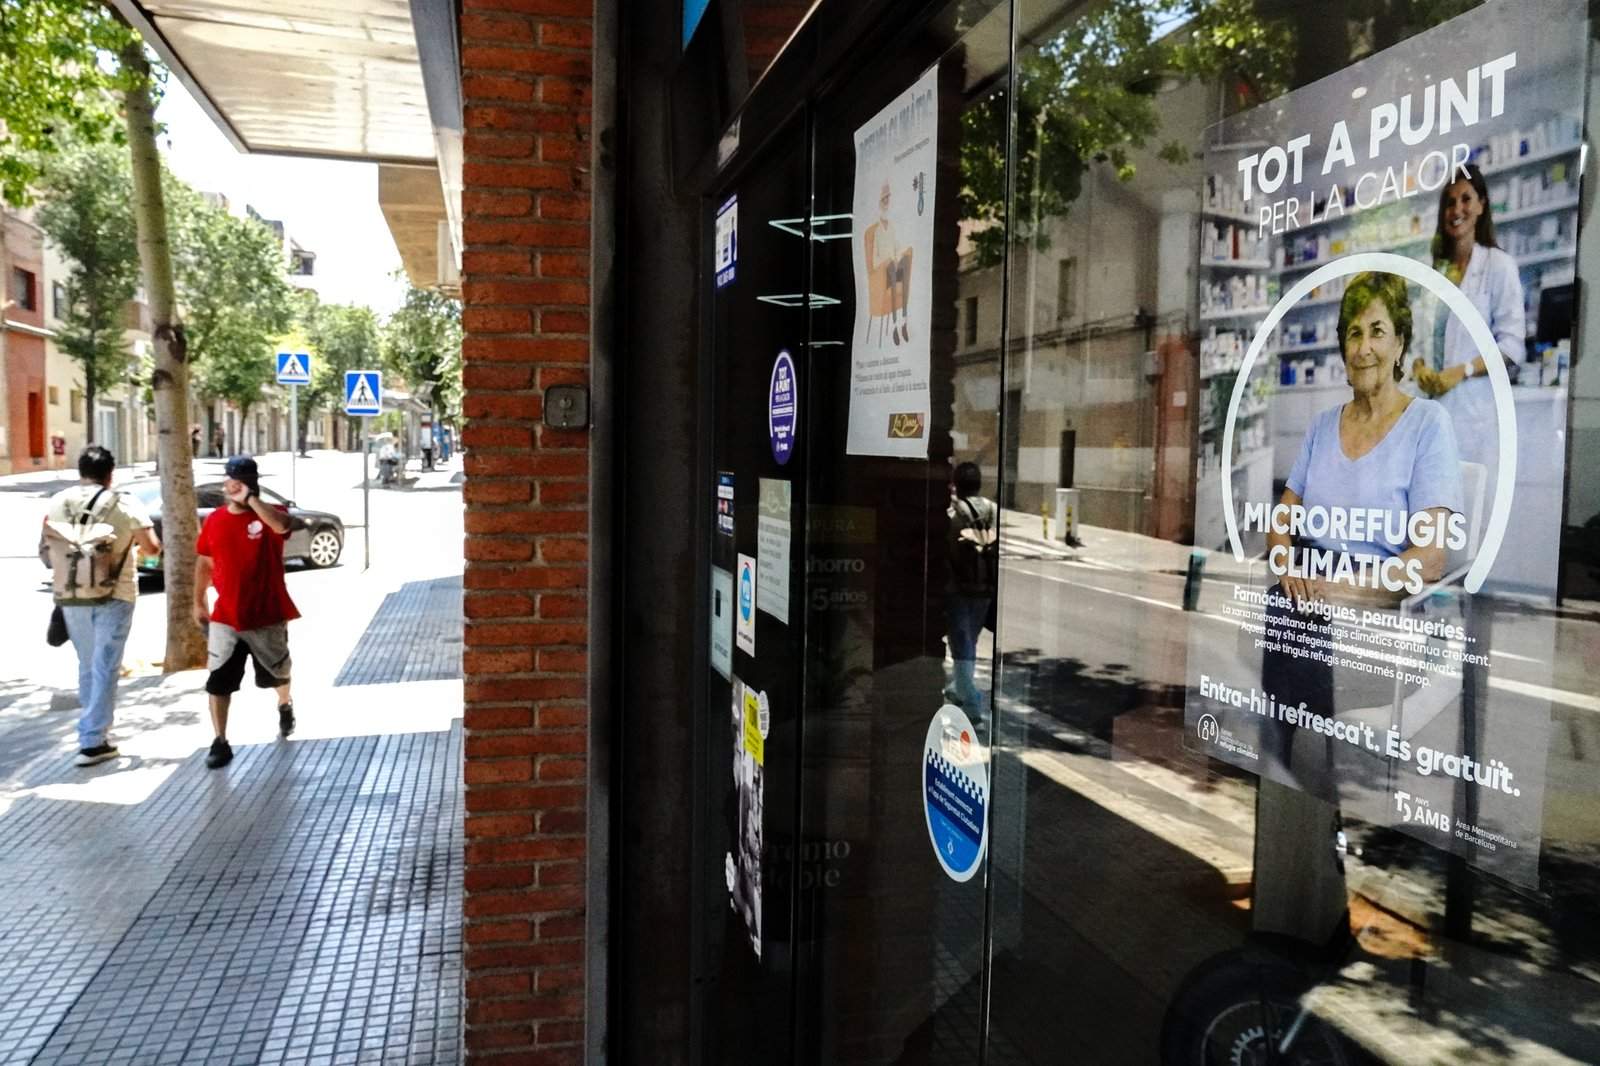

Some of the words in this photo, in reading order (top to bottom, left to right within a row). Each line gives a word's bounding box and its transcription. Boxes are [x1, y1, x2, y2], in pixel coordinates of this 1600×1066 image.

[1238, 133, 1311, 200] TOT
[1321, 120, 1356, 175] A
[1369, 52, 1517, 158] PUNT
[1258, 196, 1300, 238] PER
[1310, 184, 1345, 223] LA
[1354, 143, 1472, 211] CALOR
[1244, 502, 1467, 551] MICROREFUGIS
[1269, 543, 1424, 595] CLIMÀTICS
[1222, 604, 1231, 614] La
[1231, 608, 1250, 618] xarxa
[1251, 611, 1306, 630] metropolitana
[1307, 620, 1318, 632] de
[1319, 623, 1349, 640] refugis
[1350, 628, 1393, 647] climàtics
[1394, 639, 1440, 657] continua
[1442, 649, 1492, 667] creixent.
[1233, 585, 1295, 613] Farmàcies,
[1297, 594, 1359, 625] botigues,
[1362, 610, 1476, 643] perruqueries...
[1267, 627, 1281, 640] any
[1283, 628, 1296, 641] s'hi
[1296, 631, 1339, 650] afegeixen
[1282, 643, 1310, 658] tinguis
[1310, 649, 1339, 667] refugis
[1340, 658, 1373, 674] encara
[1374, 665, 1395, 678] més
[1396, 671, 1404, 680] a
[1404, 672, 1432, 688] prop.
[1200, 674, 1267, 716] Entra-hi
[1269, 694, 1276, 718] i
[1278, 702, 1380, 752] refresca't.
[1386, 724, 1411, 761] És
[1416, 746, 1521, 797] gratuït.
[1414, 805, 1450, 833] AMB
[1464, 832, 1497, 852] Barcelona
